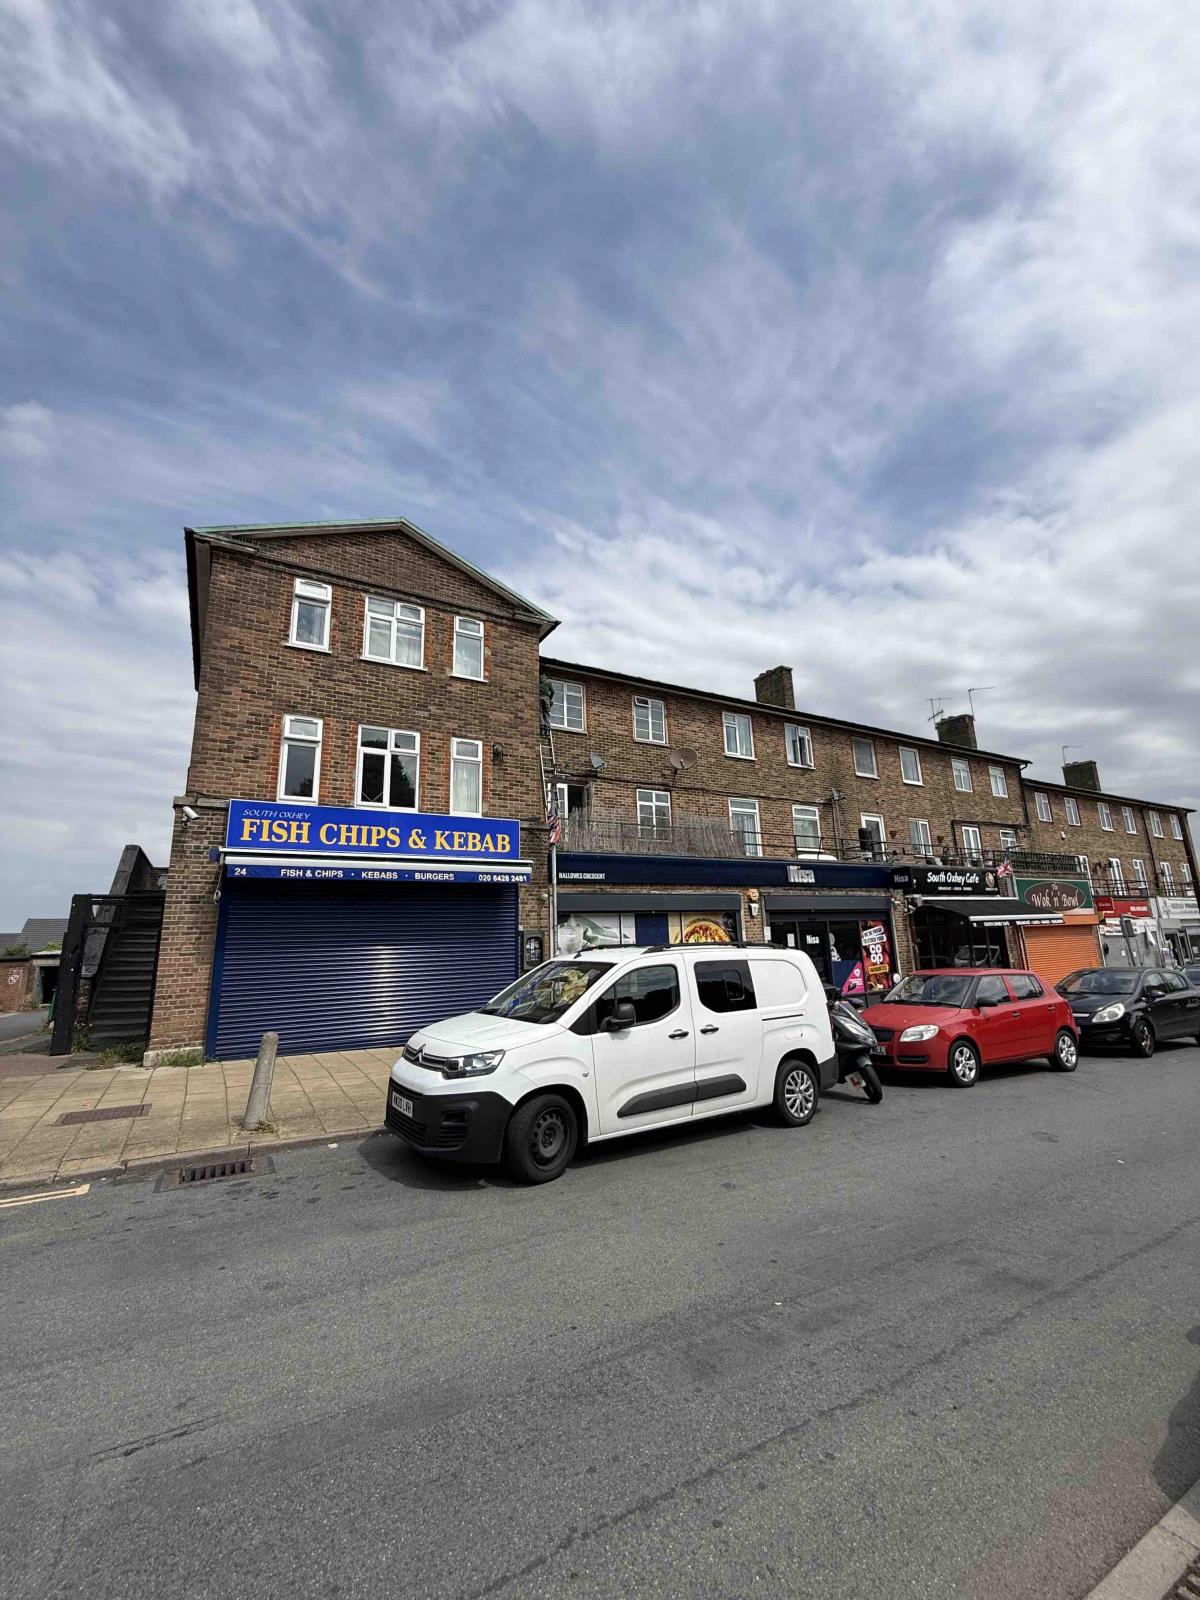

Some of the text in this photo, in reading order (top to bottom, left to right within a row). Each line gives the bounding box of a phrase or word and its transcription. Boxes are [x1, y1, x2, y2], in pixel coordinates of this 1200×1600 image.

[242, 808, 311, 820] SOUTH OXHEY
[240, 818, 511, 853] FISH CHIPS & KEBAB
[234, 867, 247, 876] 24
[280, 868, 302, 877] FISH
[305, 869, 313, 877] &
[315, 870, 344, 878] CHIPS
[361, 871, 398, 879] KEBABS
[414, 872, 455, 881] BURGERS
[478, 874, 491, 882] 020
[787, 865, 816, 883] Nisa
[927, 871, 980, 886] South Oxhey Cafe
[1031, 889, 1052, 907] Wok
[1061, 889, 1079, 907] Bowl
[806, 934, 820, 944] Nisa
